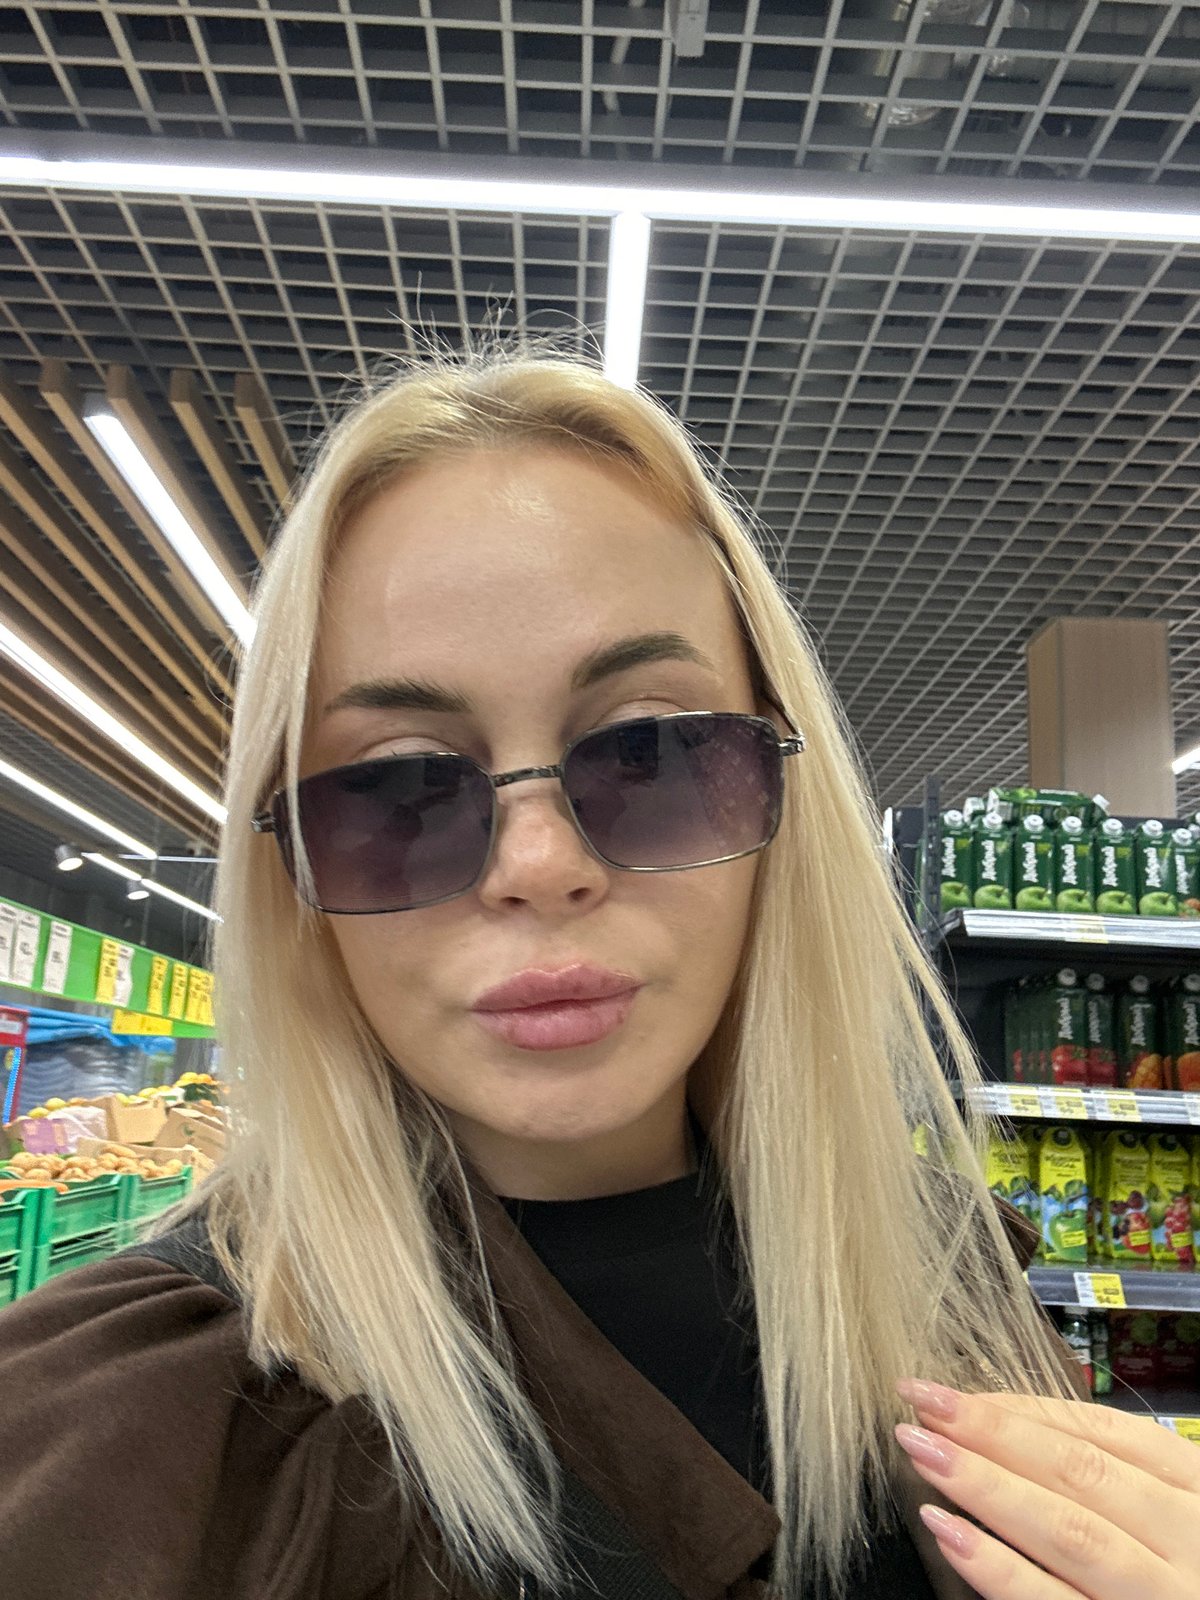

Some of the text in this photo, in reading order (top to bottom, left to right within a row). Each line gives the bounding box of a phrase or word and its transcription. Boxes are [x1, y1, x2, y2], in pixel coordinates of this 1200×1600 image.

[942, 837, 956, 878] Добрый
[982, 839, 996, 881] Добрый
[1022, 842, 1038, 883] Добрый
[1062, 844, 1077, 885] Добрый
[1101, 846, 1118, 887] Добрый
